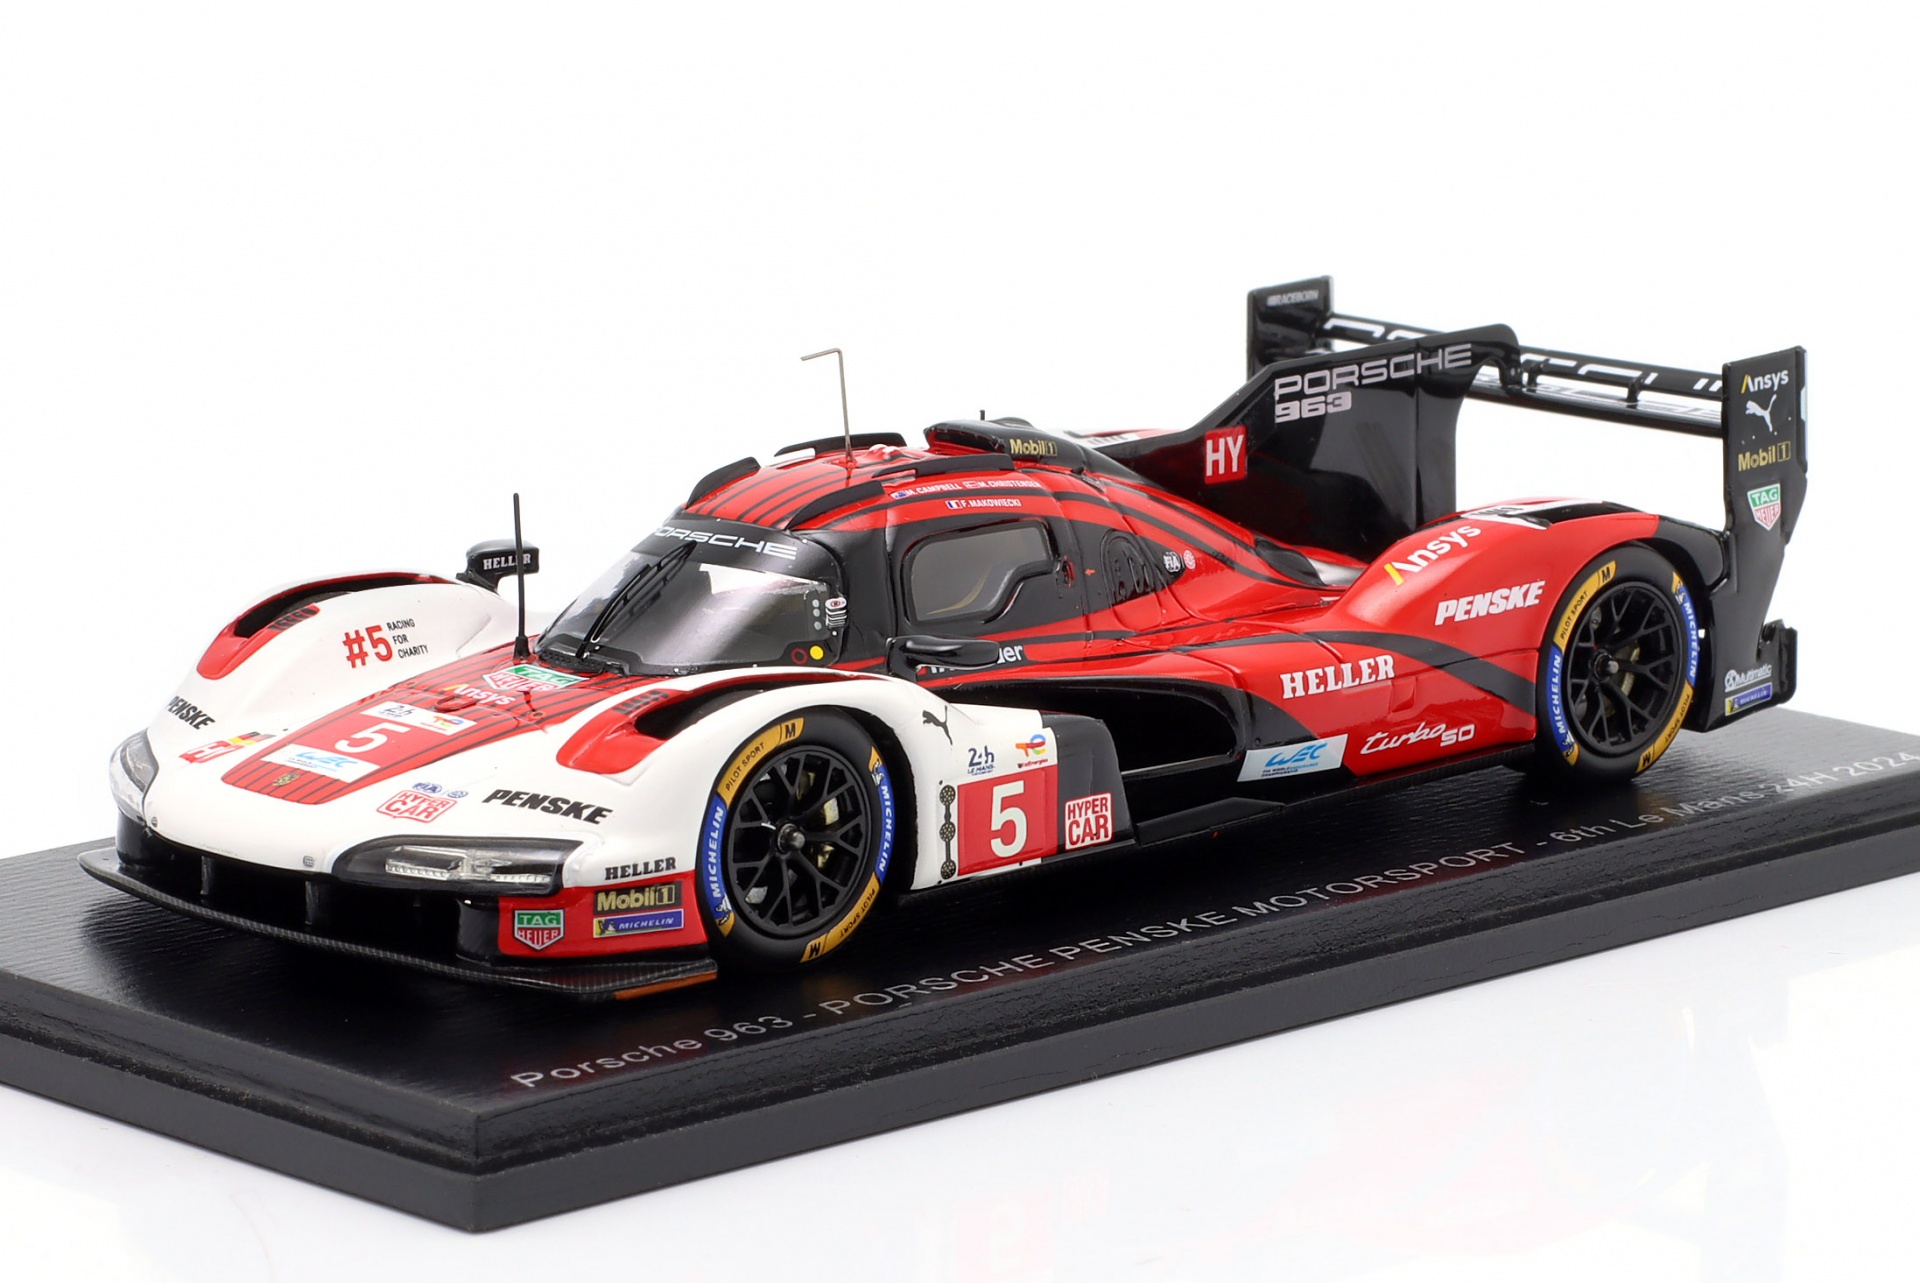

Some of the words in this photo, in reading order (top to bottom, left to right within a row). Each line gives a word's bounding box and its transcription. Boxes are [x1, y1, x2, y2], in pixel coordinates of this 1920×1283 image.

[1275, 343, 1472, 400] PORSCHE
[1741, 370, 1789, 394] Ansys
[1275, 391, 1352, 423] 963
[1010, 438, 1046, 455] Mobil
[1205, 435, 1244, 476] HY
[1738, 446, 1776, 472] Mobil
[1752, 488, 1778, 505] TAG
[1754, 503, 1780, 522] HEUER
[654, 526, 798, 560] ORSCHE
[1384, 525, 1483, 585] Ansys
[483, 553, 531, 570] HELLR
[1602, 566, 1611, 583] M
[1435, 580, 1546, 626] PENSKE
[1560, 607, 1574, 640] PILOT
[1572, 590, 1589, 614] SPORT
[386, 618, 416, 631] RACING
[342, 625, 393, 669] #5
[392, 633, 409, 645] FOR
[398, 645, 429, 658] CHARITY
[1683, 602, 1698, 678] MICHELIN
[515, 667, 578, 685] TAG
[1280, 655, 1395, 699] HELLER
[443, 684, 515, 704] Ansys
[1551, 654, 1566, 734] MICHELIN
[334, 722, 411, 753] 5
[785, 722, 796, 739] M
[1360, 721, 1447, 754] turbo
[1440, 724, 1475, 747] 50
[725, 766, 743, 792] PILOT
[742, 742, 765, 766] SPORT
[1265, 743, 1328, 767] WEC
[385, 800, 439, 819] CAR
[398, 792, 450, 809] HYPER
[482, 788, 613, 824] PENSKE
[1068, 797, 1108, 820] HYPER
[878, 784, 893, 872] MICHELIN
[990, 780, 1026, 857] 5
[1068, 814, 1109, 846] CAR
[708, 805, 725, 898] MICHELIN
[605, 857, 676, 881] HELLER
[597, 887, 656, 911] Mobil
[861, 888, 875, 914] PILOT
[510, 1038, 703, 1087] Porsche
[704, 1015, 793, 1042] 963
[819, 954, 1055, 1016] PORSCHE
[1050, 909, 1237, 960] PENSKE
[1231, 842, 1526, 918] MOTORSPORT
[1550, 824, 1616, 843] 6th
[1609, 813, 1665, 829] Le
[1661, 788, 1766, 818] Mans
[1758, 771, 1839, 794] 24H
[1832, 751, 1920, 777] 2024
[520, 915, 557, 926] TAG
[618, 917, 674, 930] MICHELIN
[841, 912, 861, 937] SPORT
[518, 930, 558, 945] HEUER
[809, 941, 821, 959] M
